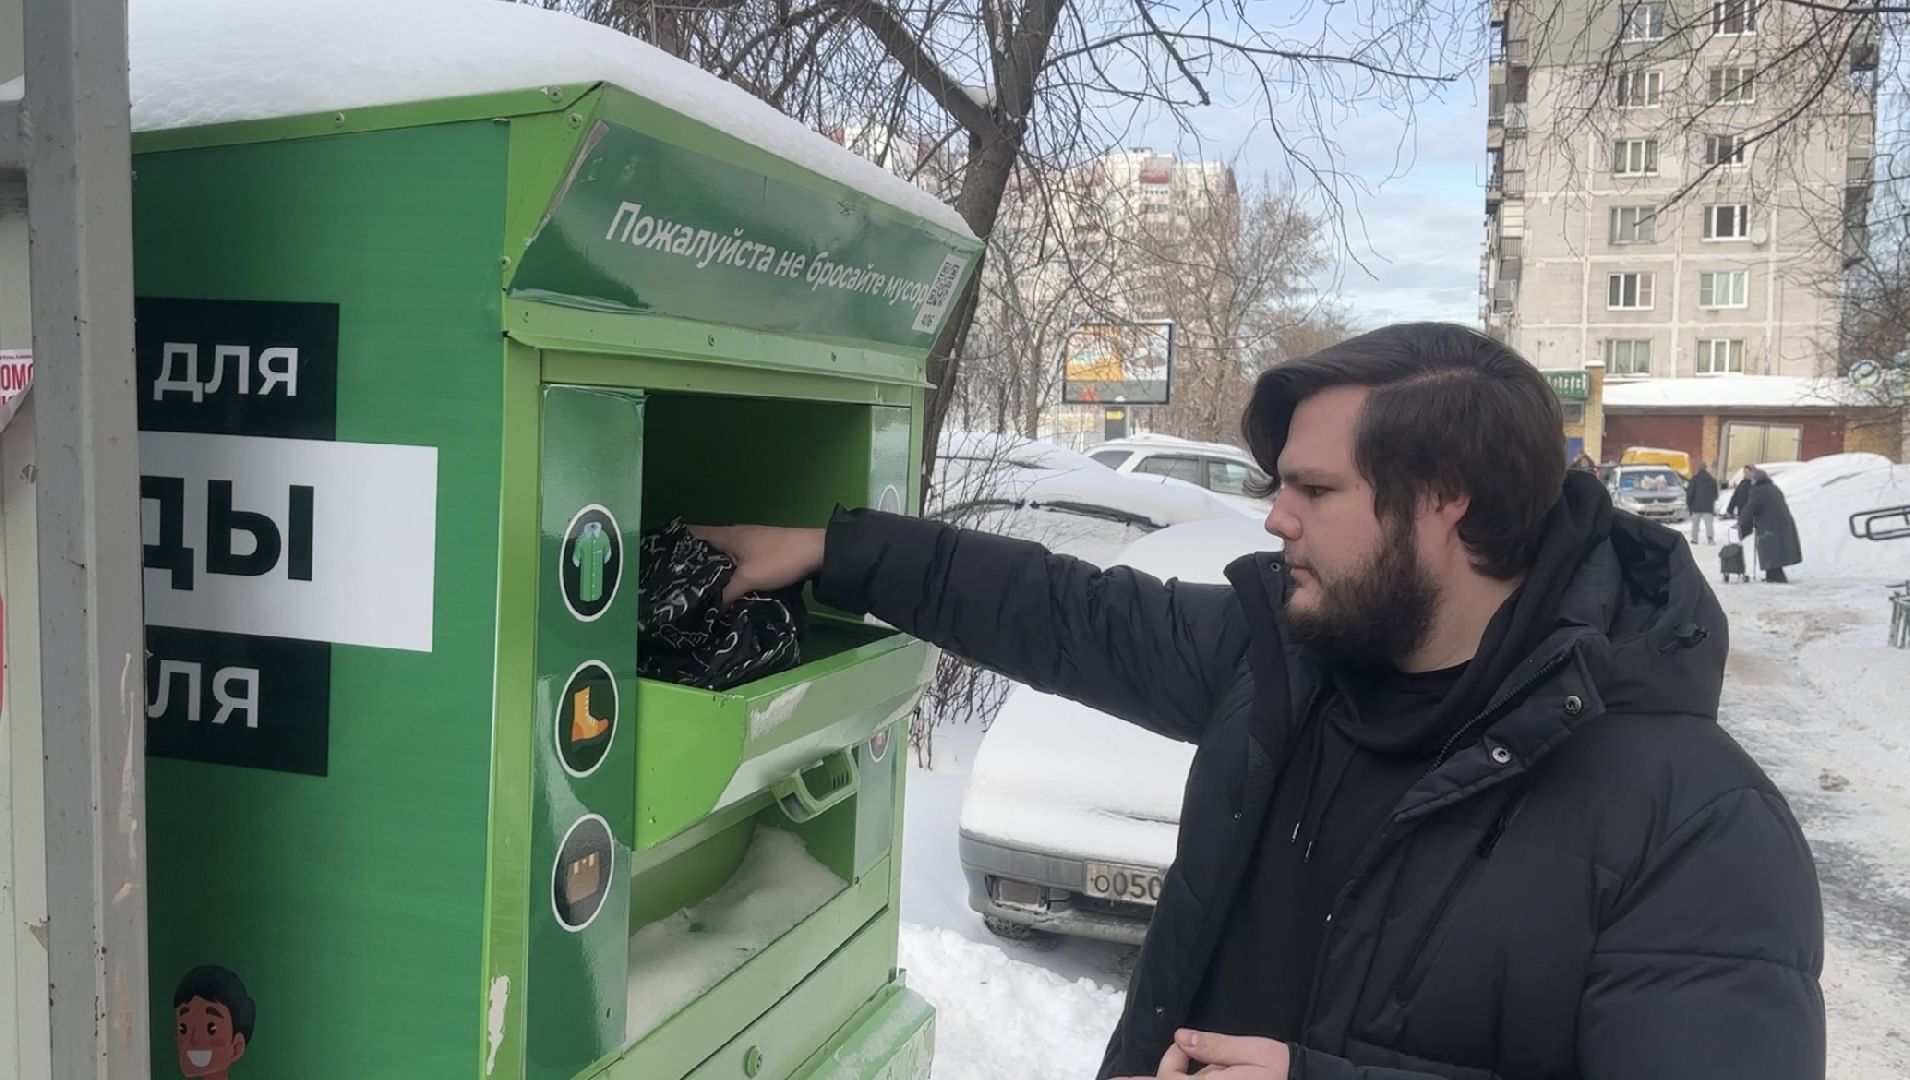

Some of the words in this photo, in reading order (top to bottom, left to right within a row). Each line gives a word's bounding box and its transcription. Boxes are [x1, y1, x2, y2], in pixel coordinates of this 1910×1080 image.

[605, 200, 777, 269] Пожалуйста
[774, 250, 806, 279] не
[806, 251, 886, 295] бросайте
